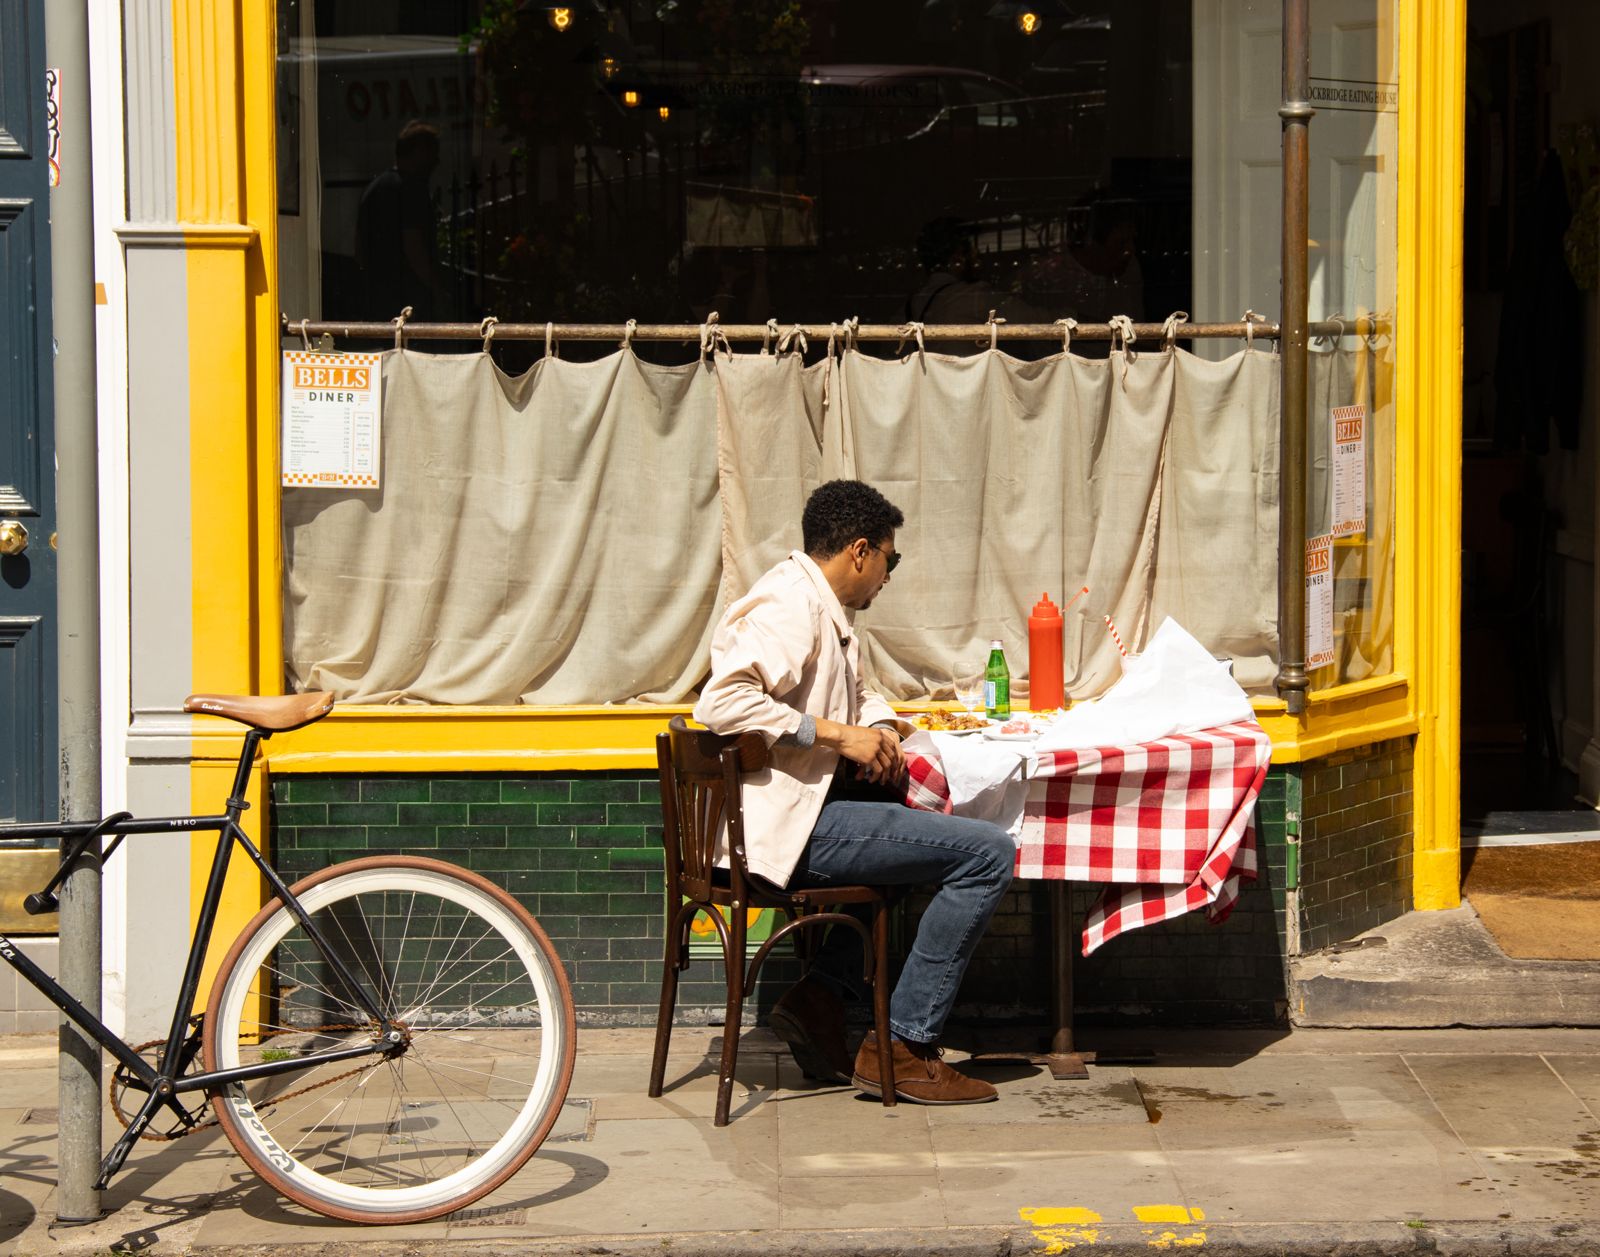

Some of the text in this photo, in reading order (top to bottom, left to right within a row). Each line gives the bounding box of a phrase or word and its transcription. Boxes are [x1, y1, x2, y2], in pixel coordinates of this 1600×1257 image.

[674, 79, 788, 97] OCKBRIDGE
[1306, 86, 1397, 105] OCKBRIDGE EATING HOUSE
[298, 367, 367, 389] BELLS
[308, 391, 355, 403] DINER
[1337, 421, 1361, 441] BELLS
[1340, 443, 1357, 455] DINER
[1305, 550, 1329, 573] ELLS
[1305, 574, 1325, 588] DINER
[170, 819, 197, 827] NERO
